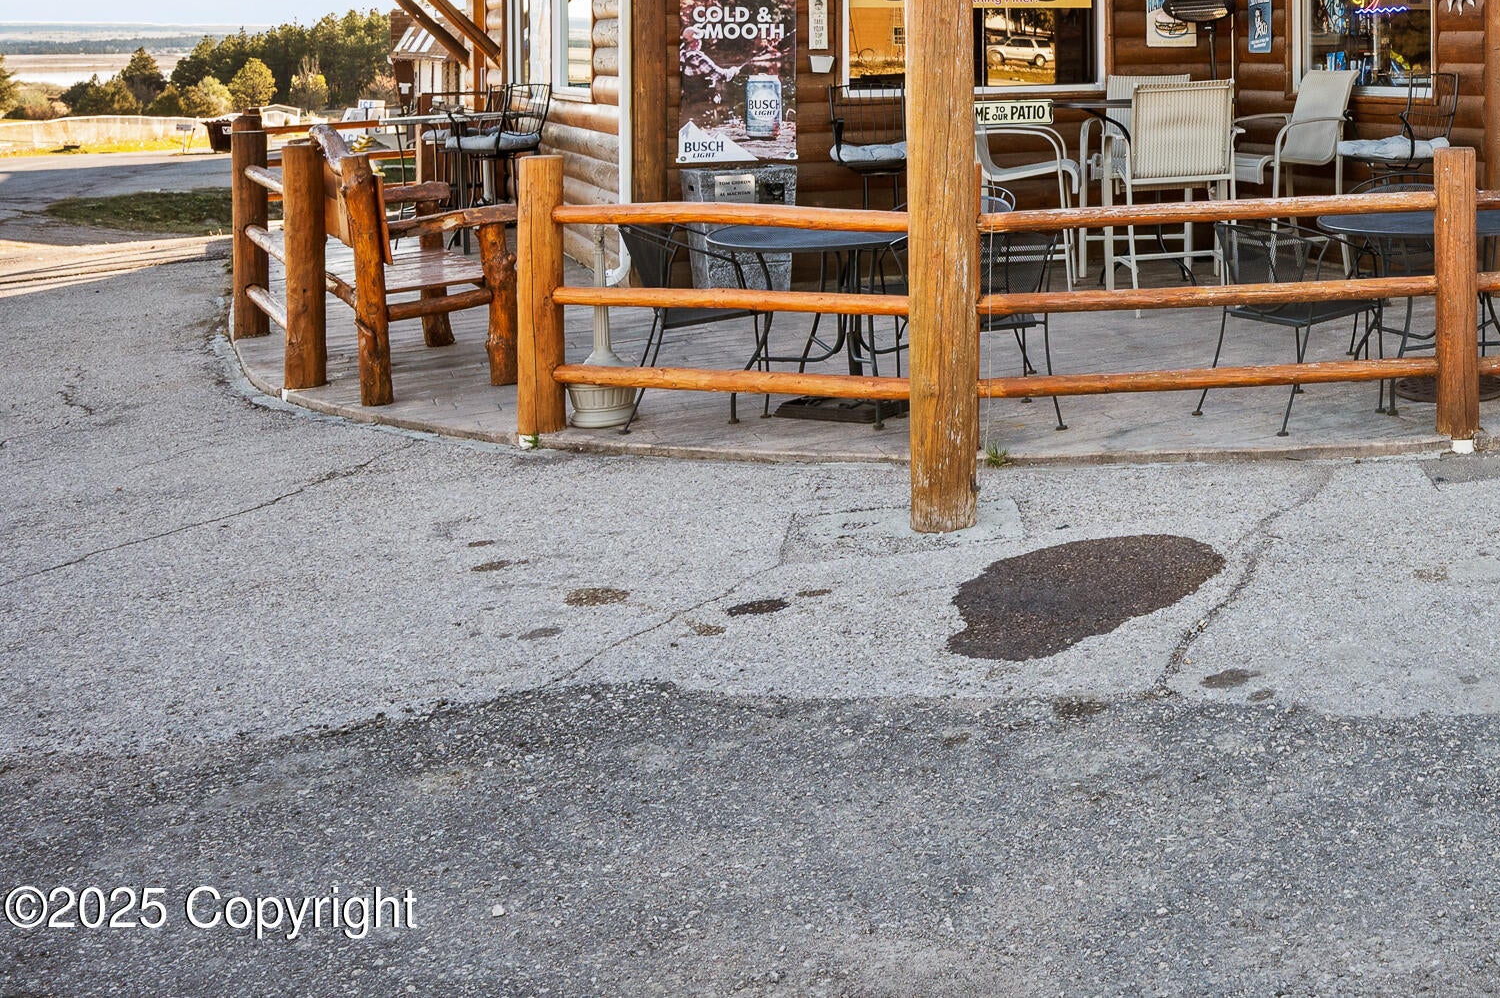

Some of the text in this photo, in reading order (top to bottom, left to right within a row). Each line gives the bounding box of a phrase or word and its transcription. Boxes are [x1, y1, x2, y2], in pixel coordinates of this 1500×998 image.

[692, 6, 773, 23] COLD &
[692, 23, 785, 40] SMOOTH
[748, 99, 780, 110] BUSCH
[991, 113, 1008, 121] OUR
[1010, 105, 1045, 120] PATIO
[684, 141, 724, 153] BUSCH
